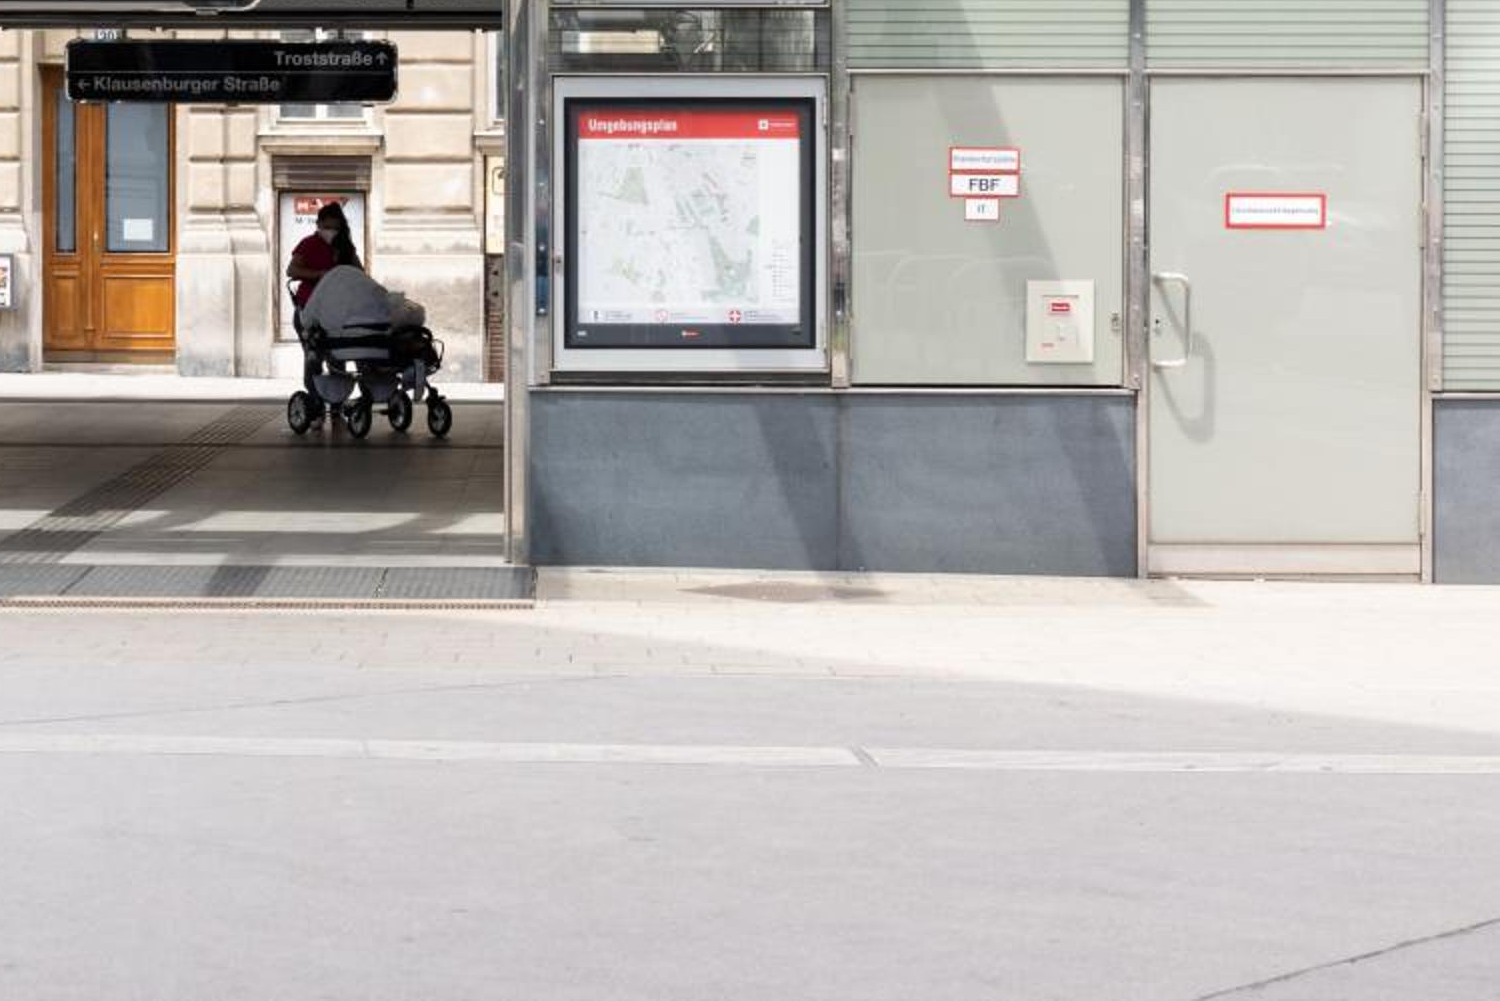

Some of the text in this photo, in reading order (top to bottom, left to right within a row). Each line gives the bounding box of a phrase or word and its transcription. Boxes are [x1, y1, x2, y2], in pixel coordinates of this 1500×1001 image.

[273, 50, 373, 66] Troststraße
[93, 76, 280, 93] Klausenburger Straße
[588, 118, 677, 134] Umgebungsplan
[968, 178, 1001, 192] FBF
